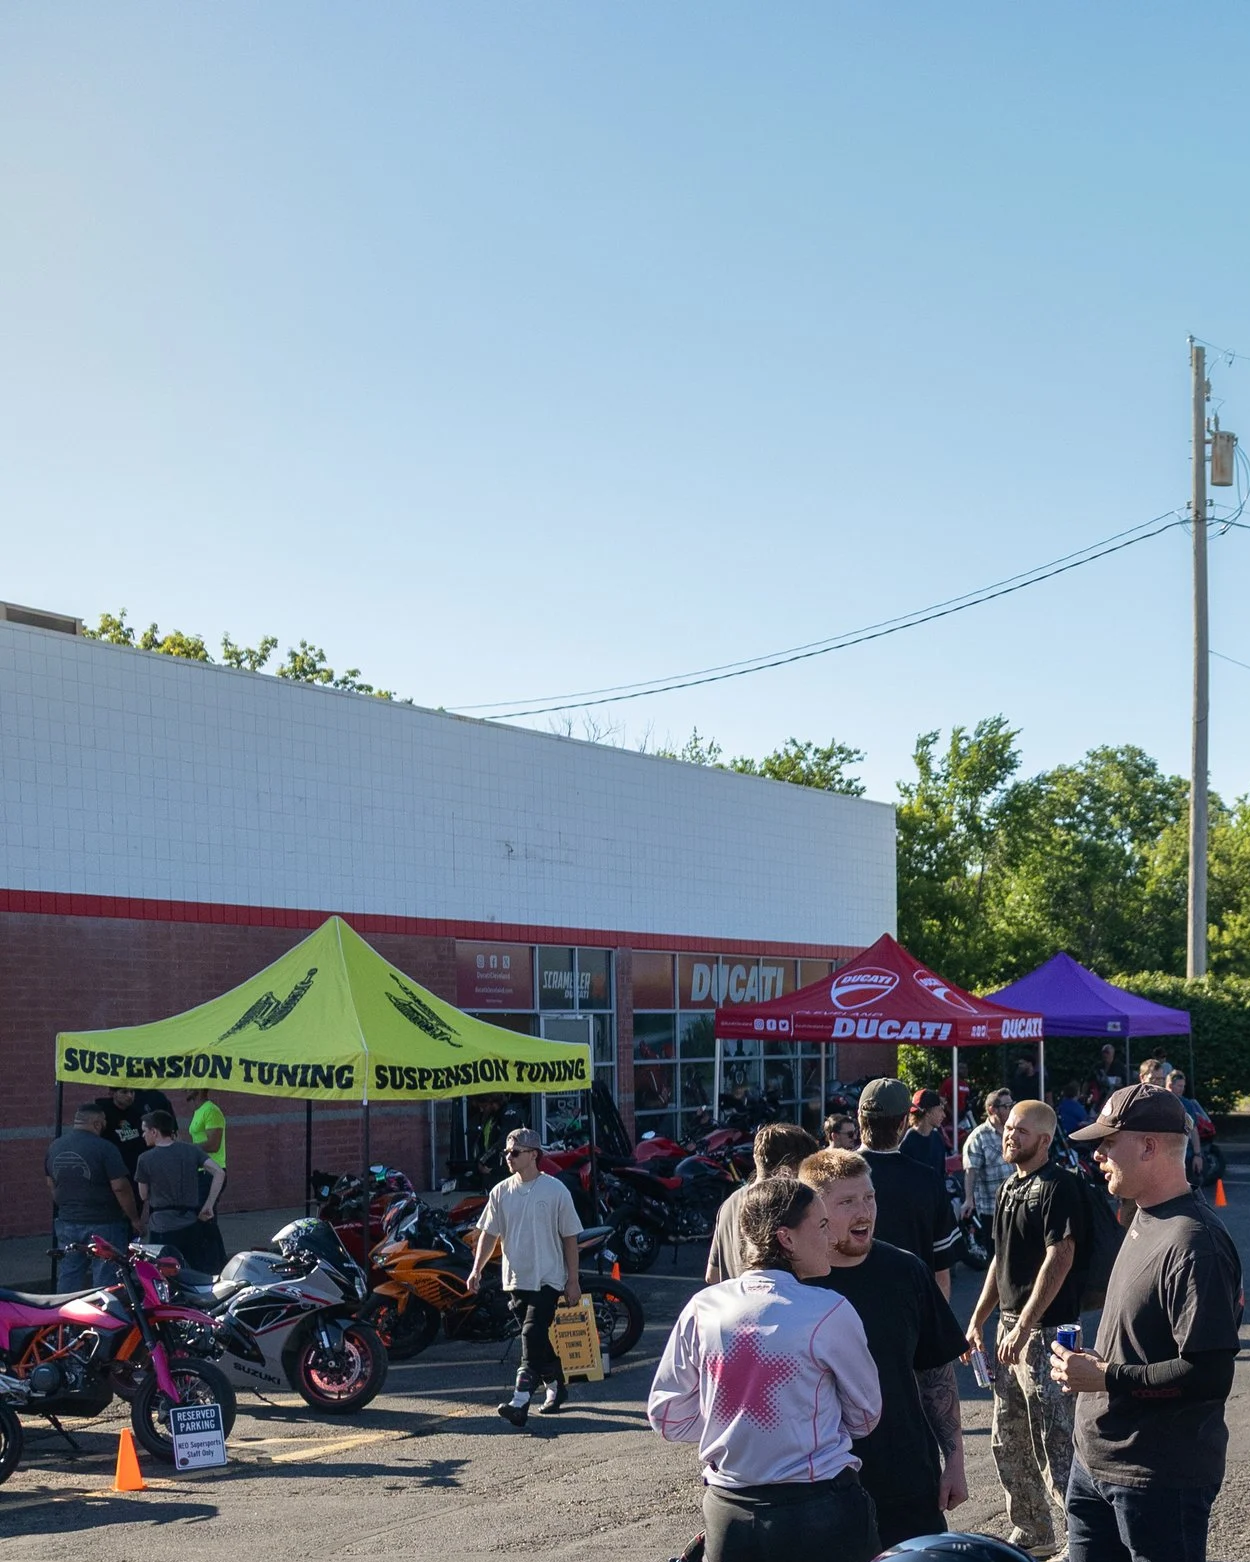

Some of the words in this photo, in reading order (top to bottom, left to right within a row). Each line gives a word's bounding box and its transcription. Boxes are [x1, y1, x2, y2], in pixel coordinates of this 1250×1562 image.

[691, 963, 785, 1004] DUCATI
[841, 974, 893, 986] DUCATI
[831, 1017, 953, 1041] DUCATI
[1001, 1017, 1042, 1040] DUCATI
[63, 1047, 233, 1080] SUSPENSION
[239, 1057, 354, 1090] TUNING
[375, 1057, 510, 1091] SUSPENSION
[513, 1057, 586, 1083] TUNING
[558, 1330, 587, 1338] SUSPENSION
[233, 1362, 281, 1385] SUZUKI
[177, 1408, 216, 1422] RESERVED
[180, 1419, 216, 1432] PARKING
[202, 1449, 214, 1457] Only
